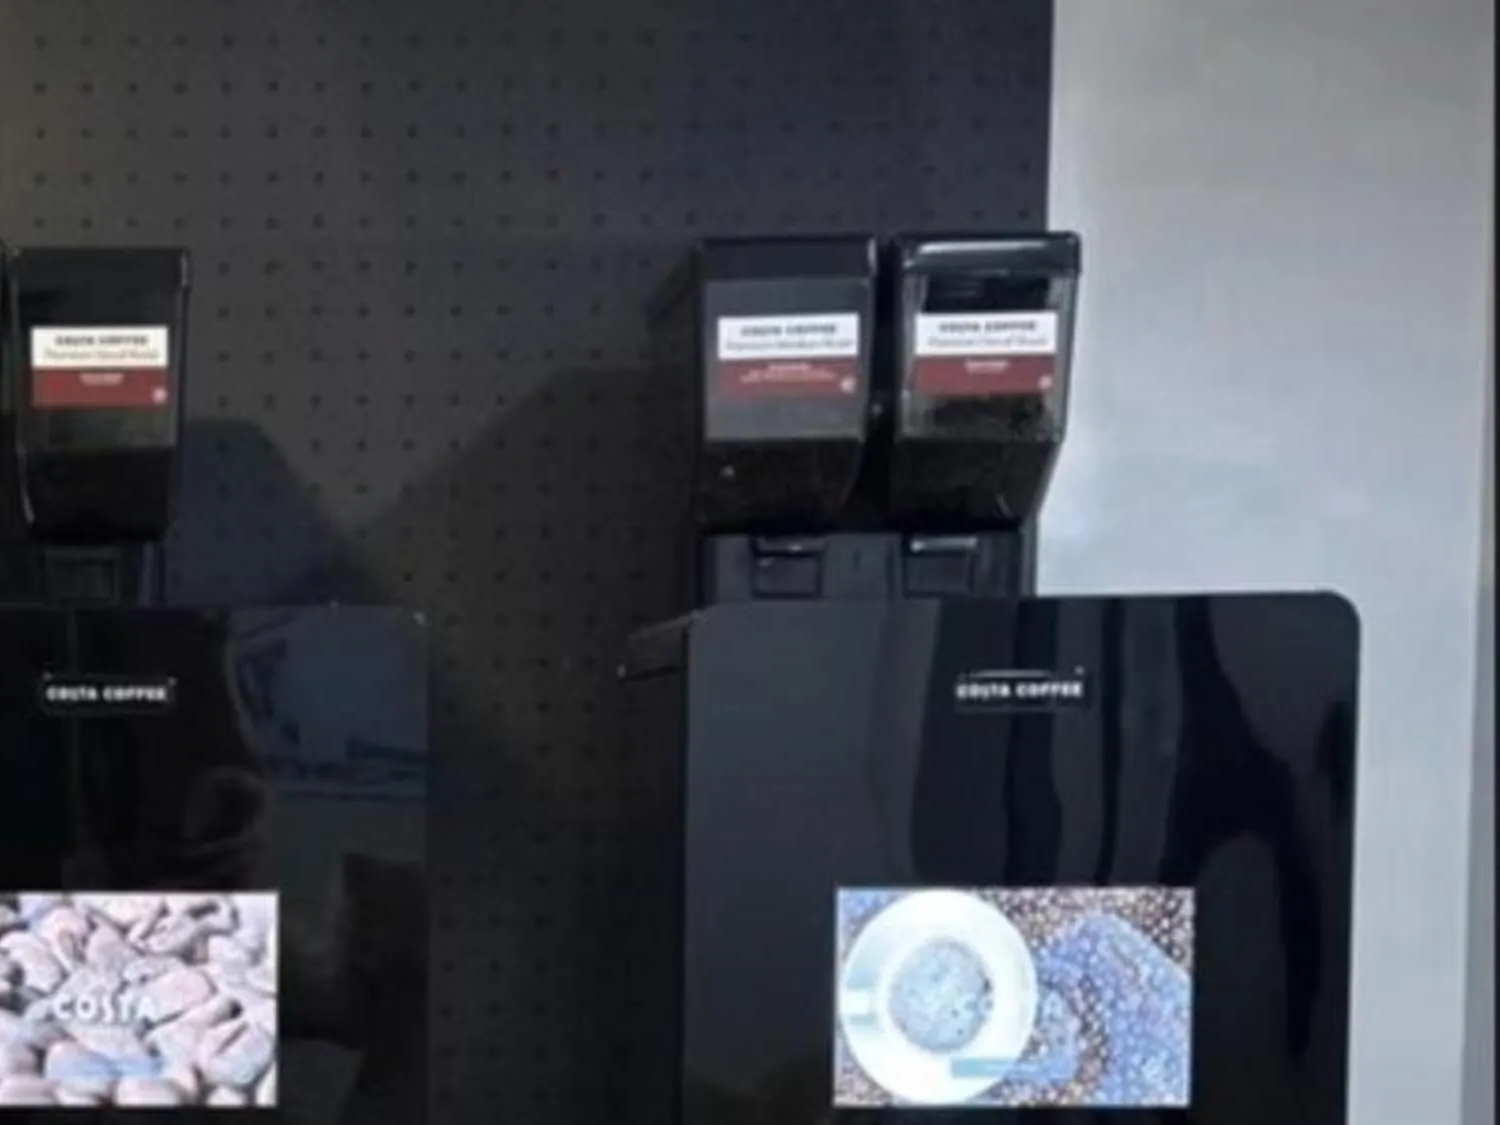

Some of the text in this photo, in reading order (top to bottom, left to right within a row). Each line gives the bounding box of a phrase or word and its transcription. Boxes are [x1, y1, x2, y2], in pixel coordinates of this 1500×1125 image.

[46, 684, 167, 702] COSTA COFFEE
[956, 680, 1083, 701] COSTA COFFEE
[52, 992, 158, 1023] COSTA
